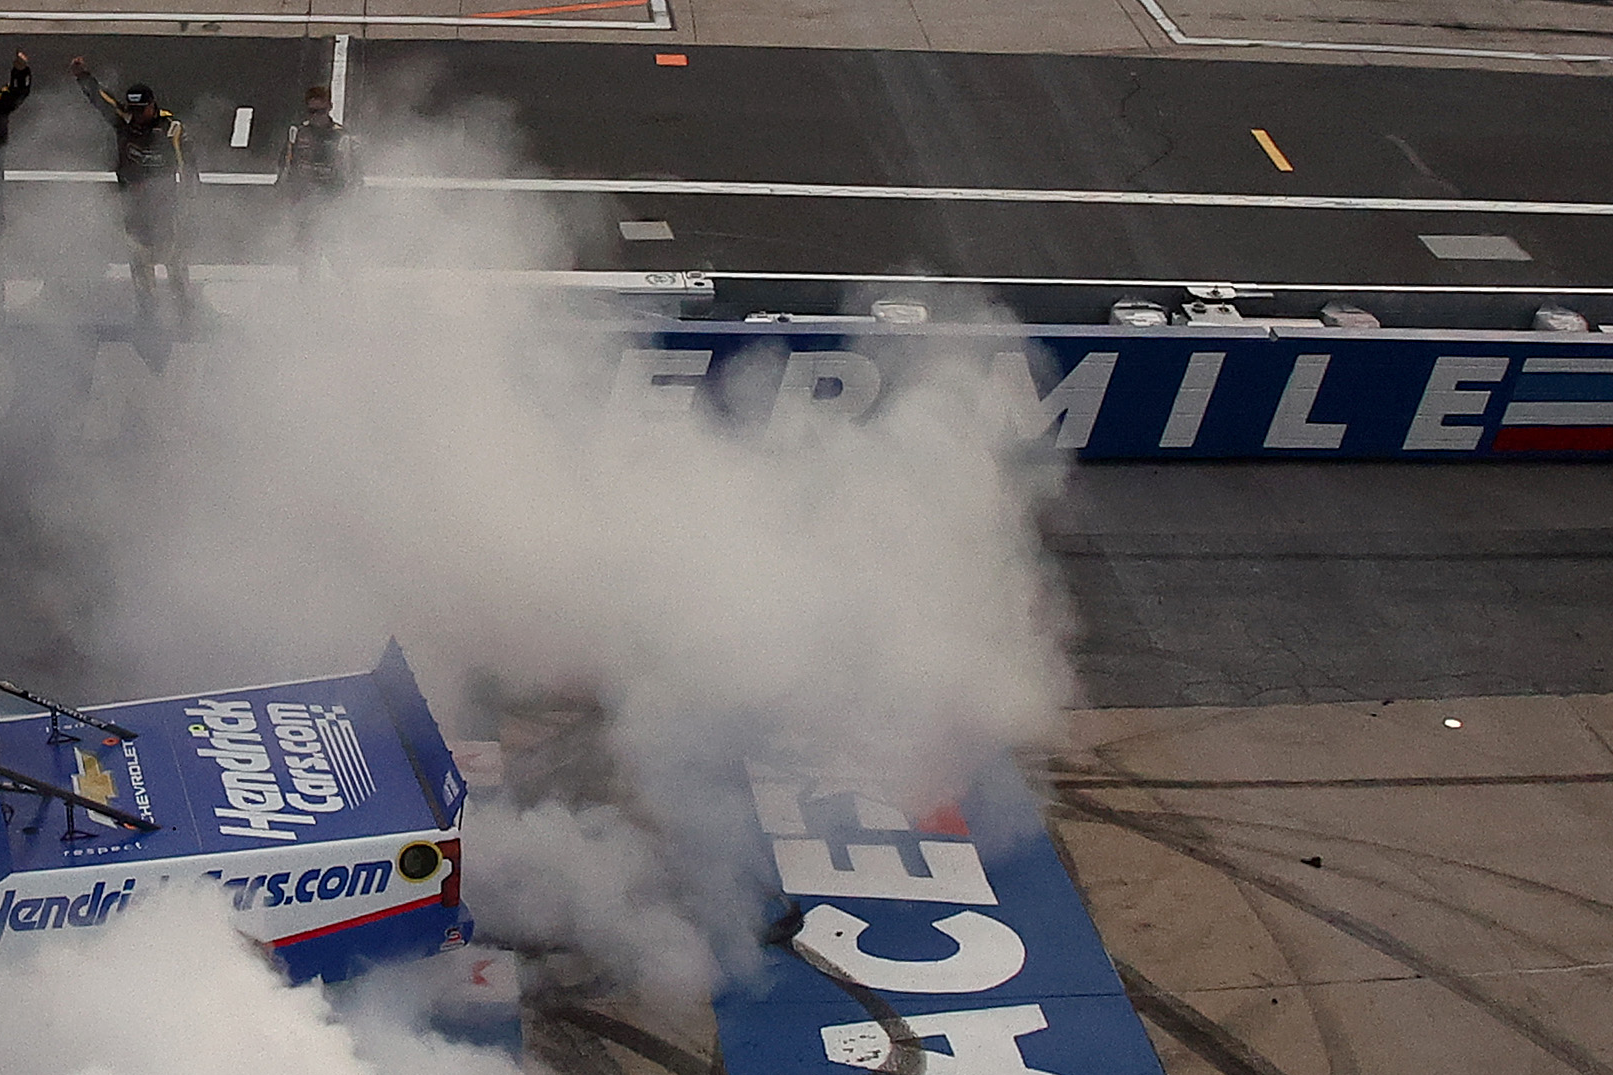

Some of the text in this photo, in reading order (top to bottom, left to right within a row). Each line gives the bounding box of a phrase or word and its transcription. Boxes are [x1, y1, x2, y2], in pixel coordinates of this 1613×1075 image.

[988, 350, 1509, 450] MILE
[183, 698, 318, 841] Hendrick
[266, 702, 346, 813] Cars.com
